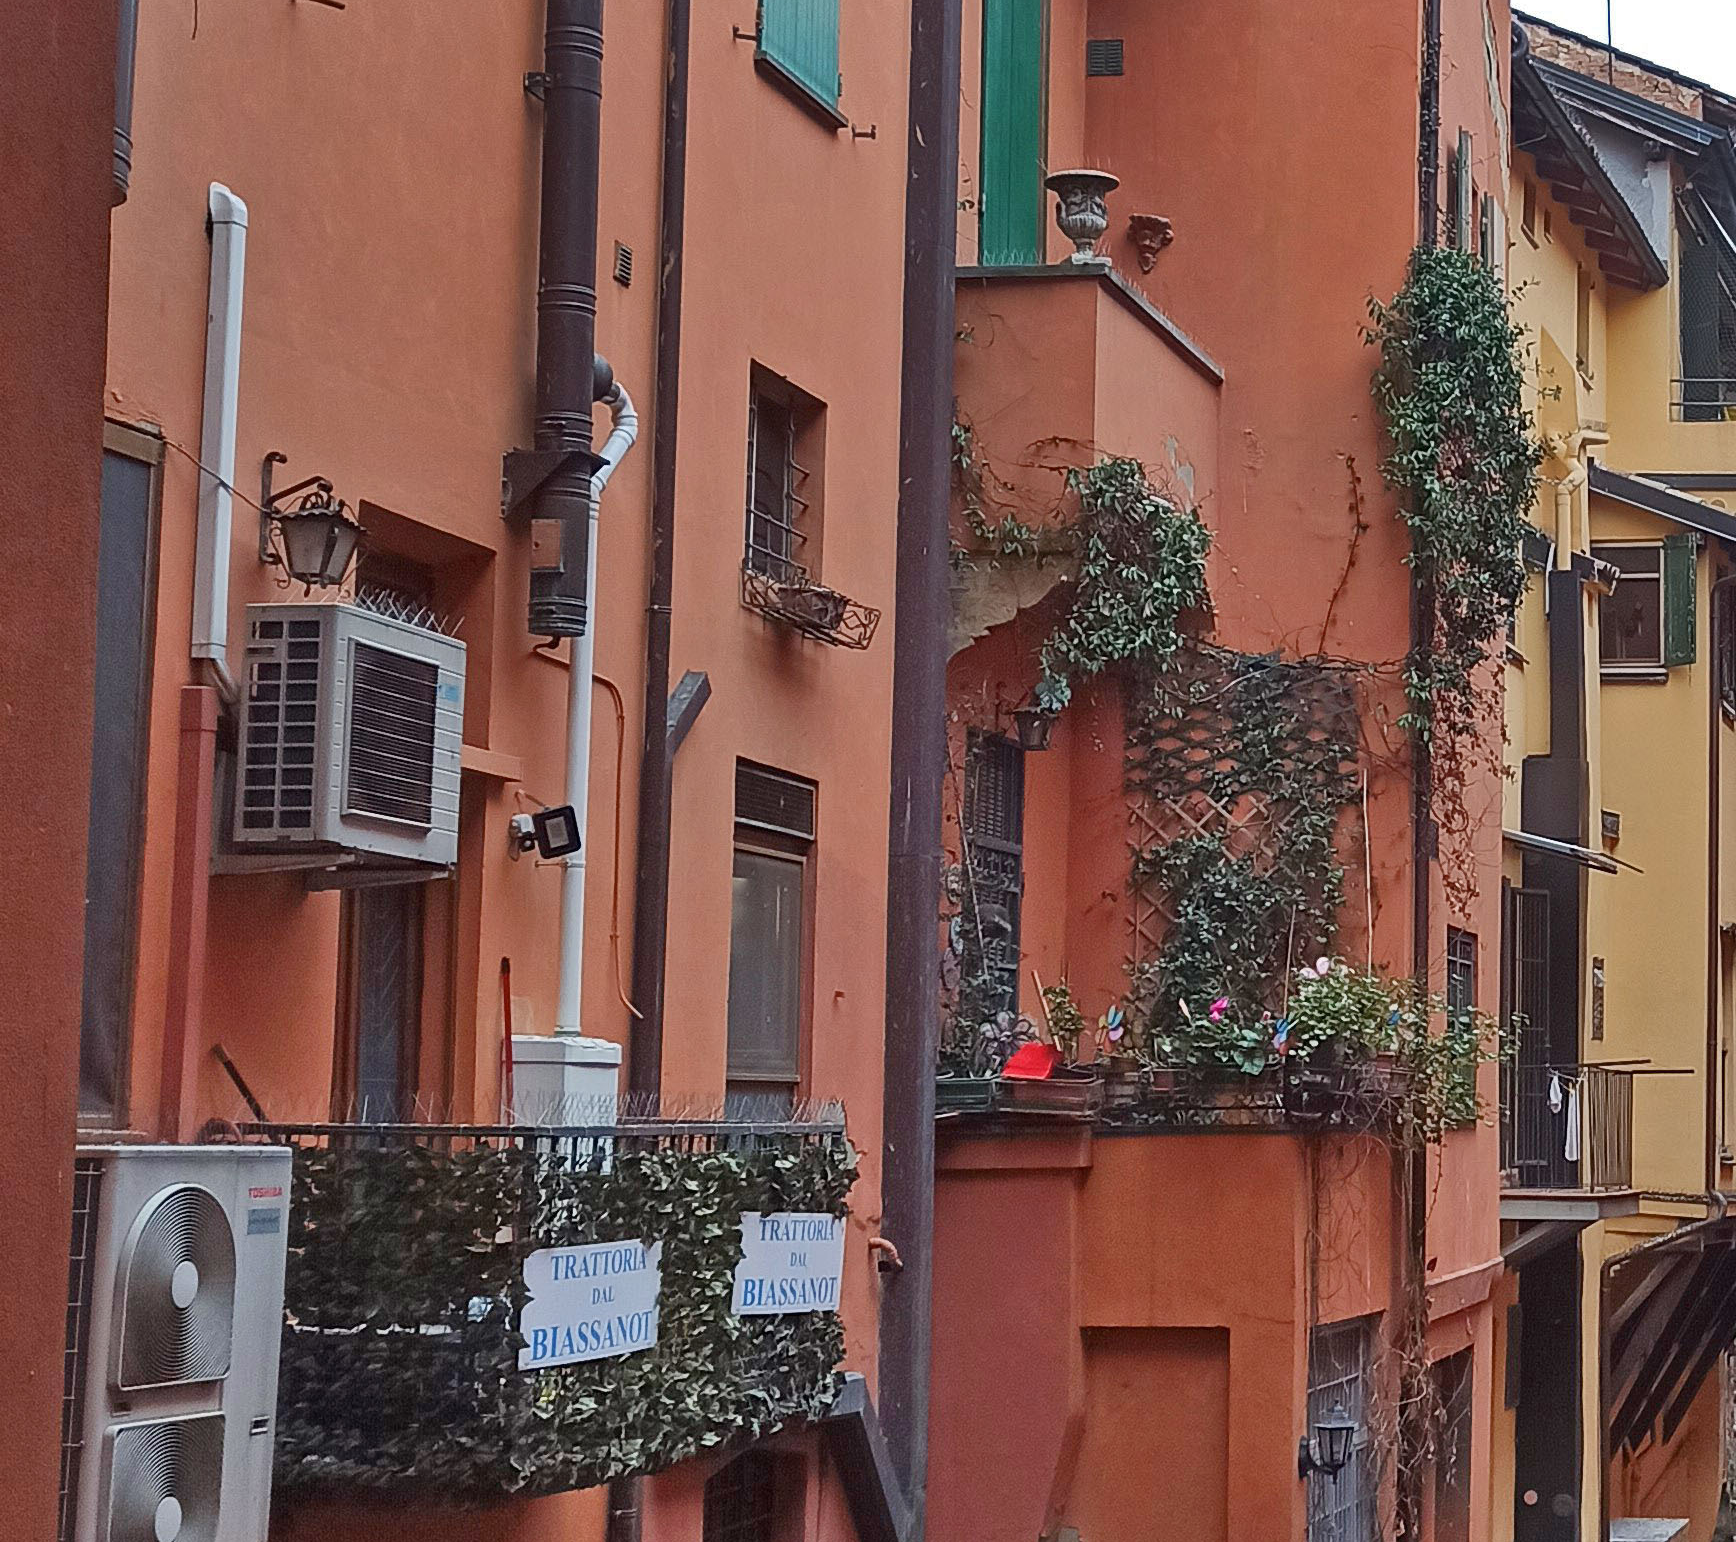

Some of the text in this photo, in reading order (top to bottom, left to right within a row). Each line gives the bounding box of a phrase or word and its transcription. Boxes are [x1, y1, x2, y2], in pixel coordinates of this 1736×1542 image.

[759, 1219, 834, 1242] TRATTORIA
[551, 1247, 647, 1281] TRATTORIA
[790, 1252, 807, 1267] DAL
[592, 1286, 615, 1305] DAL
[742, 1277, 838, 1307] BIASSANOT
[531, 1310, 653, 1361] BIASSANOT
